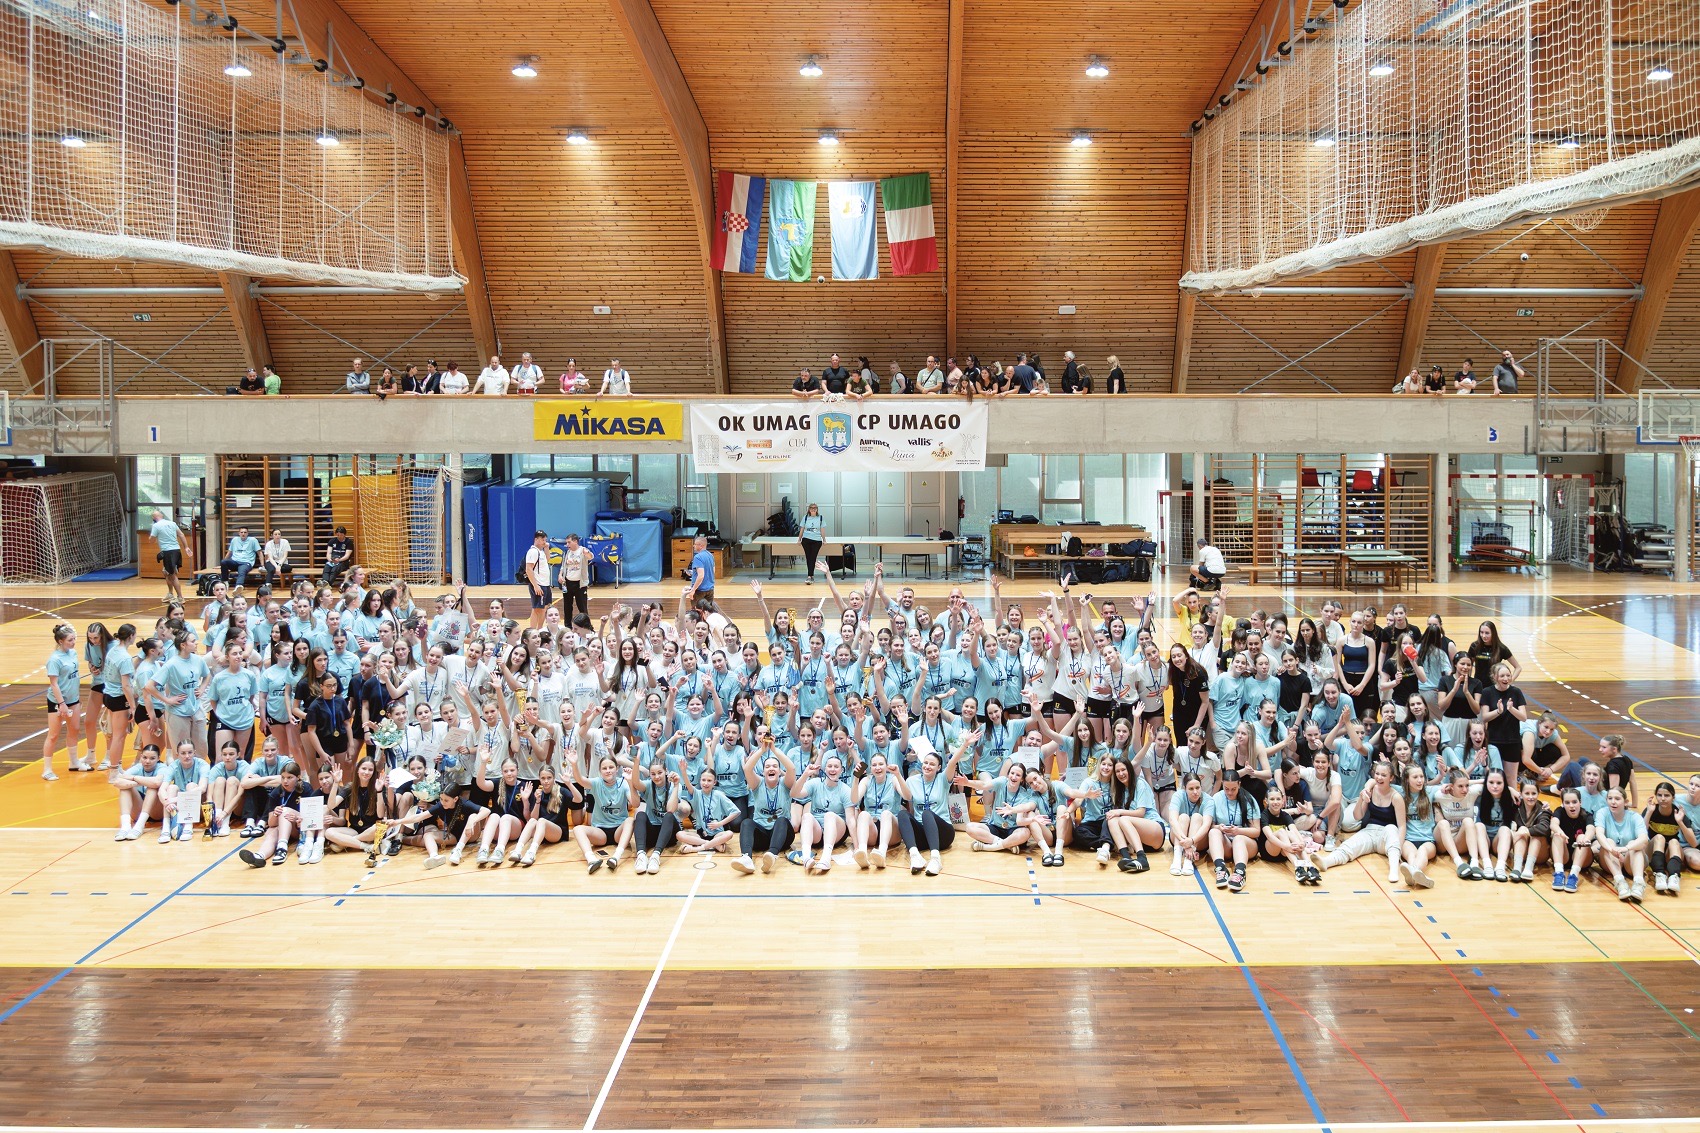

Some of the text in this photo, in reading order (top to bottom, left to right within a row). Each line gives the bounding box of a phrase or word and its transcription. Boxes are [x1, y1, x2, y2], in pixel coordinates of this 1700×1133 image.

[553, 413, 666, 435] MIKASA
[718, 414, 811, 431] OK UMAG
[857, 414, 961, 430] CP UMAGO
[151, 426, 157, 442] 1
[907, 437, 932, 446] vallis
[1489, 426, 1498, 442] 3
